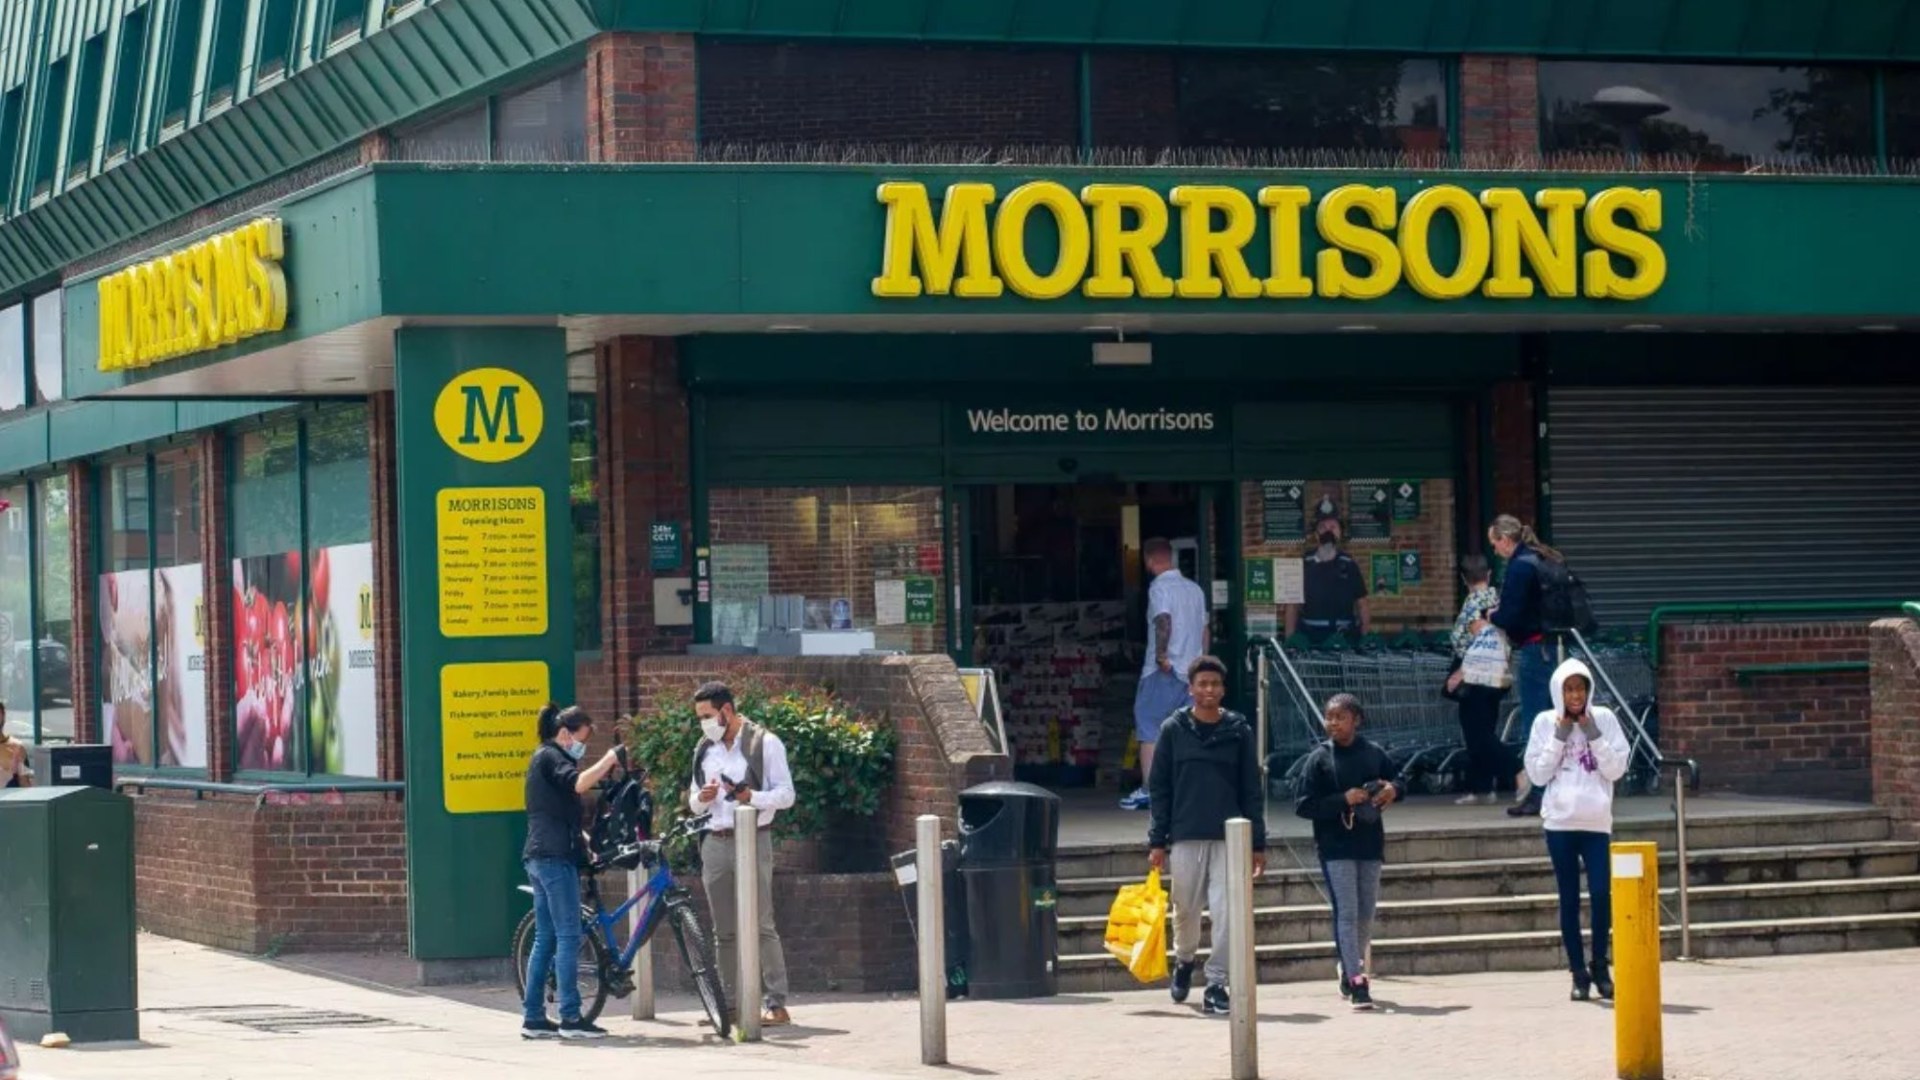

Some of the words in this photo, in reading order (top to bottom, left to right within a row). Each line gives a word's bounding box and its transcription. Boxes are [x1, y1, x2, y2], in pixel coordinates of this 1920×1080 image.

[872, 180, 1667, 299] MORRISONS
[97, 217, 287, 372] MORRISONS
[458, 386, 525, 444] M
[967, 408, 1069, 433] Welcome
[1075, 409, 1098, 431] to
[1104, 407, 1215, 431] Morrisons
[448, 496, 538, 512] MORRISONS
[462, 516, 499, 527] Opening
[501, 515, 524, 525] Hours
[652, 533, 676, 541] CCTV
[912, 599, 928, 608] Only
